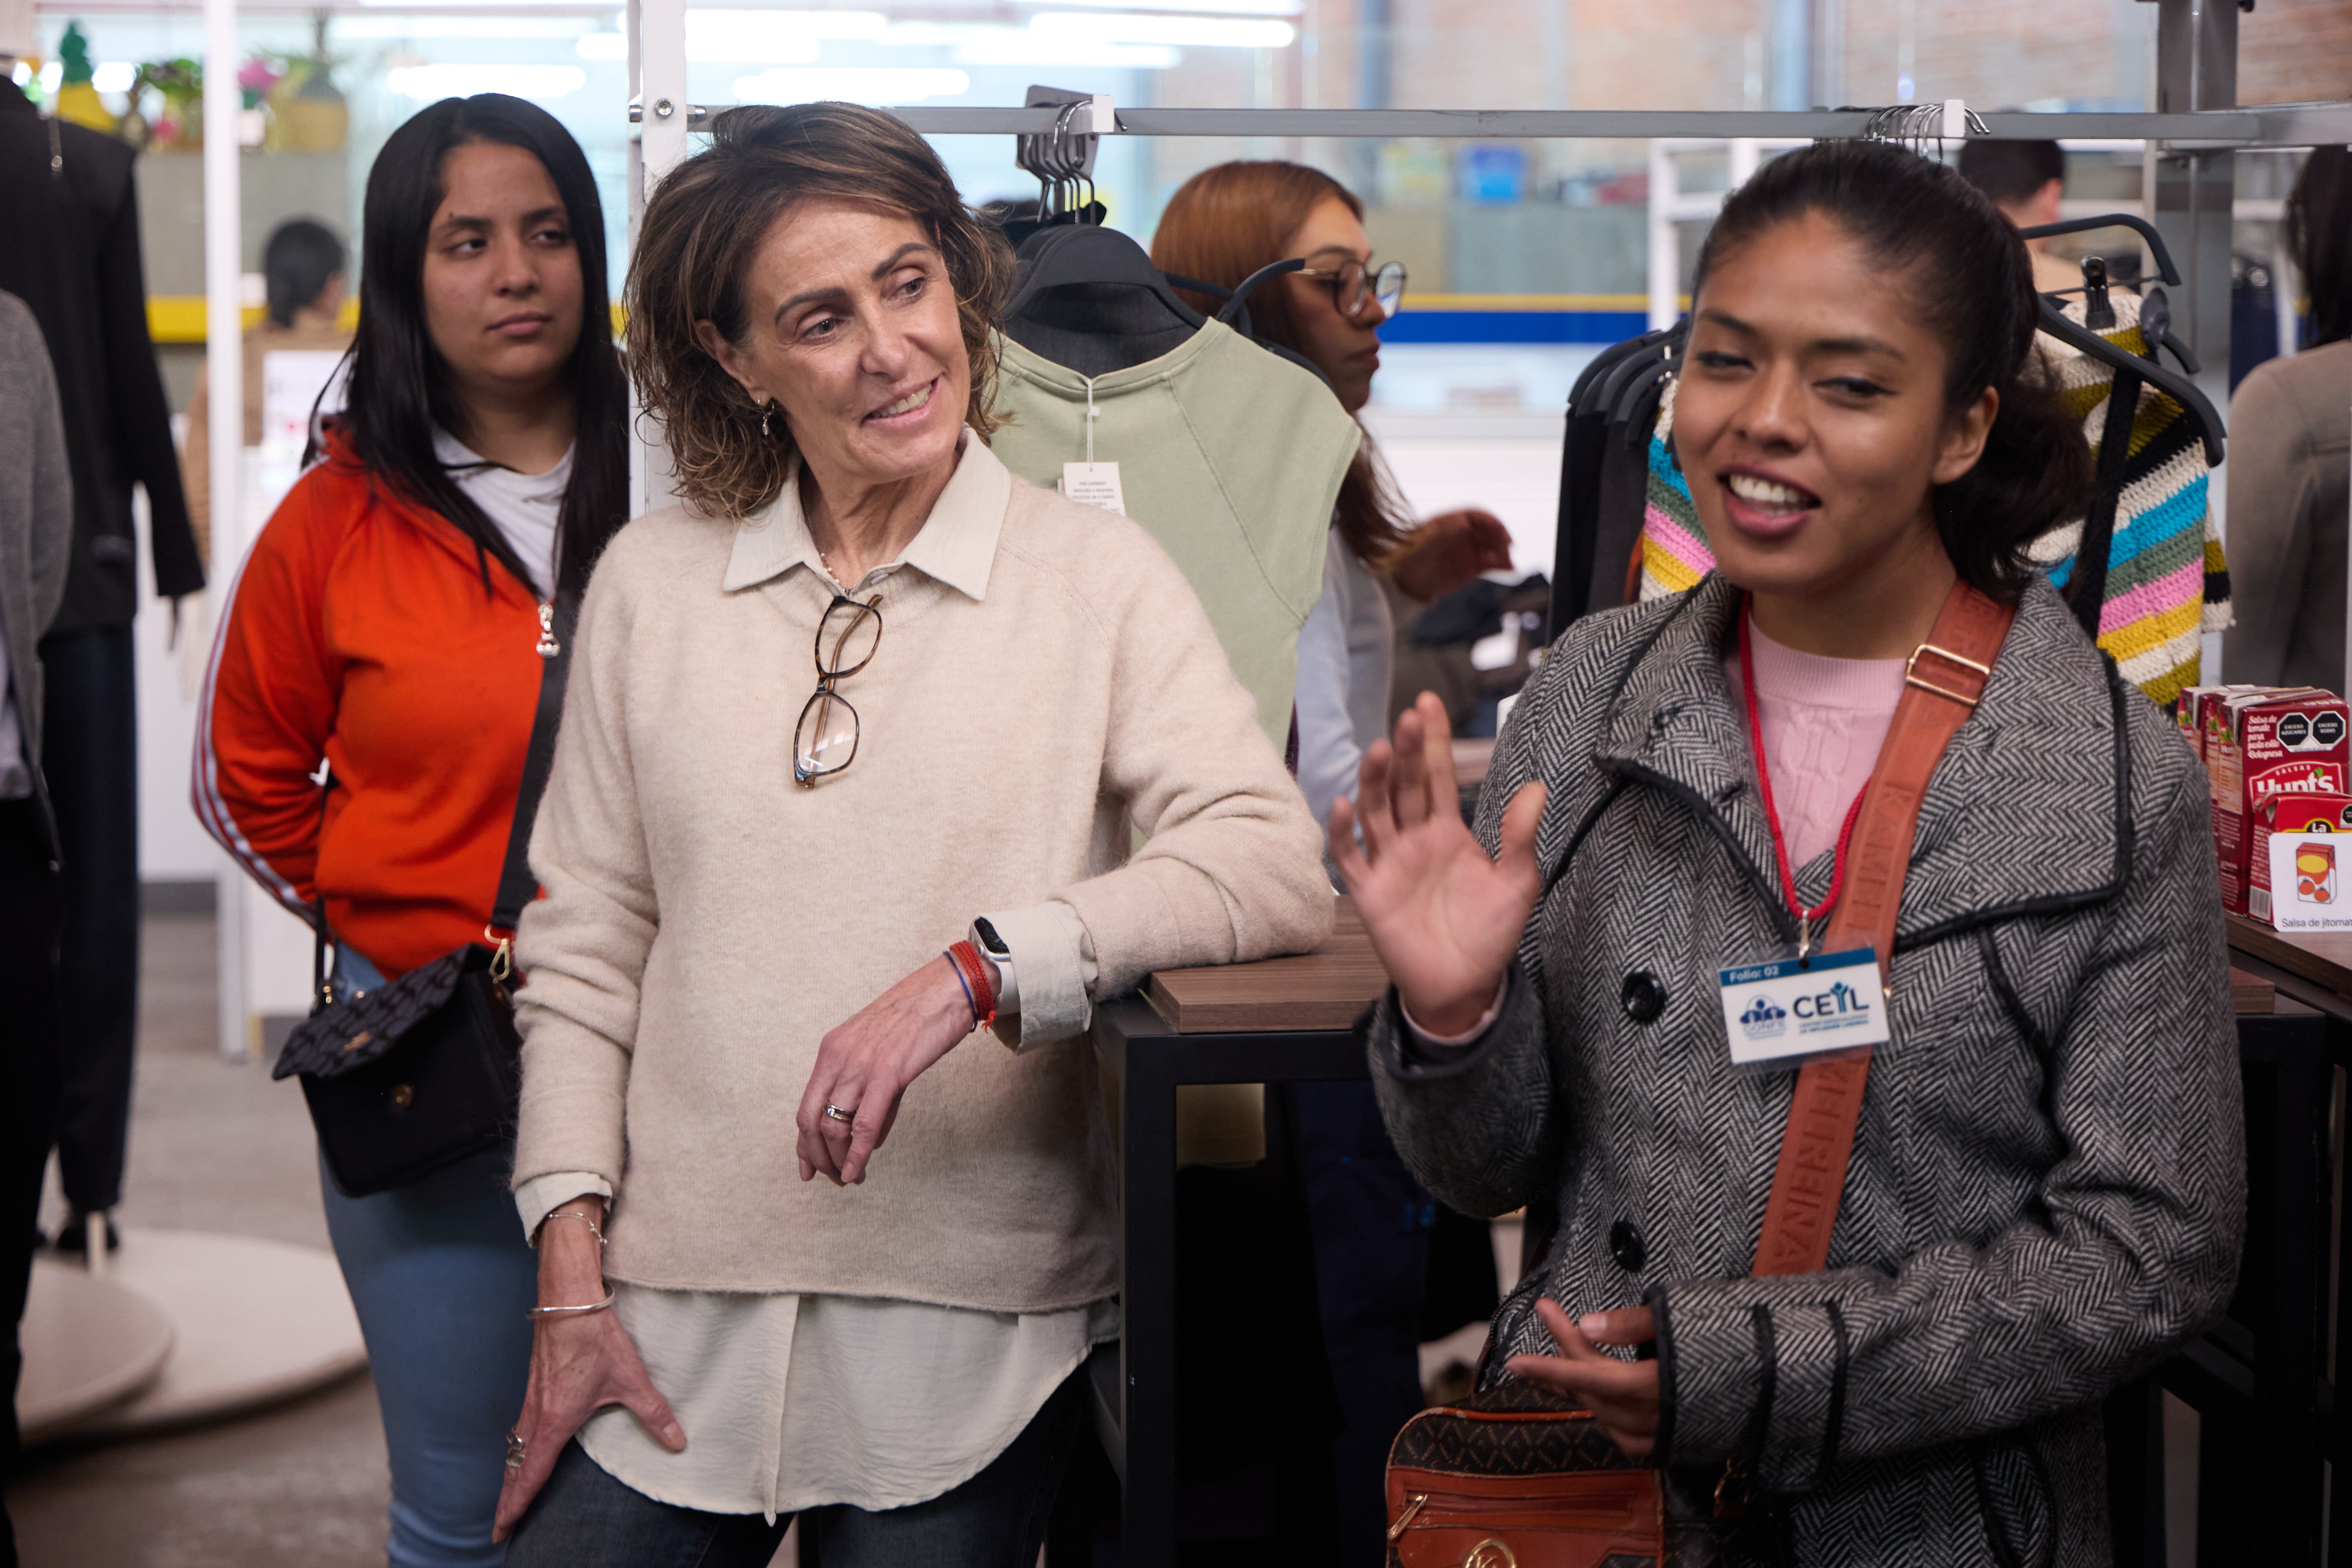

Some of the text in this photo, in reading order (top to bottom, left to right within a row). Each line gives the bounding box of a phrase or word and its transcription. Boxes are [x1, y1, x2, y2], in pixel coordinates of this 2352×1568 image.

[2248, 715, 2278, 725] Salsa de
[2247, 733, 2265, 743] para
[2276, 764, 2311, 776] SALSAS
[2311, 823, 2327, 833] La
[2282, 918, 2306, 927] Salsa
[2308, 918, 2320, 927] de
[1729, 965, 1779, 983] Folio: 02
